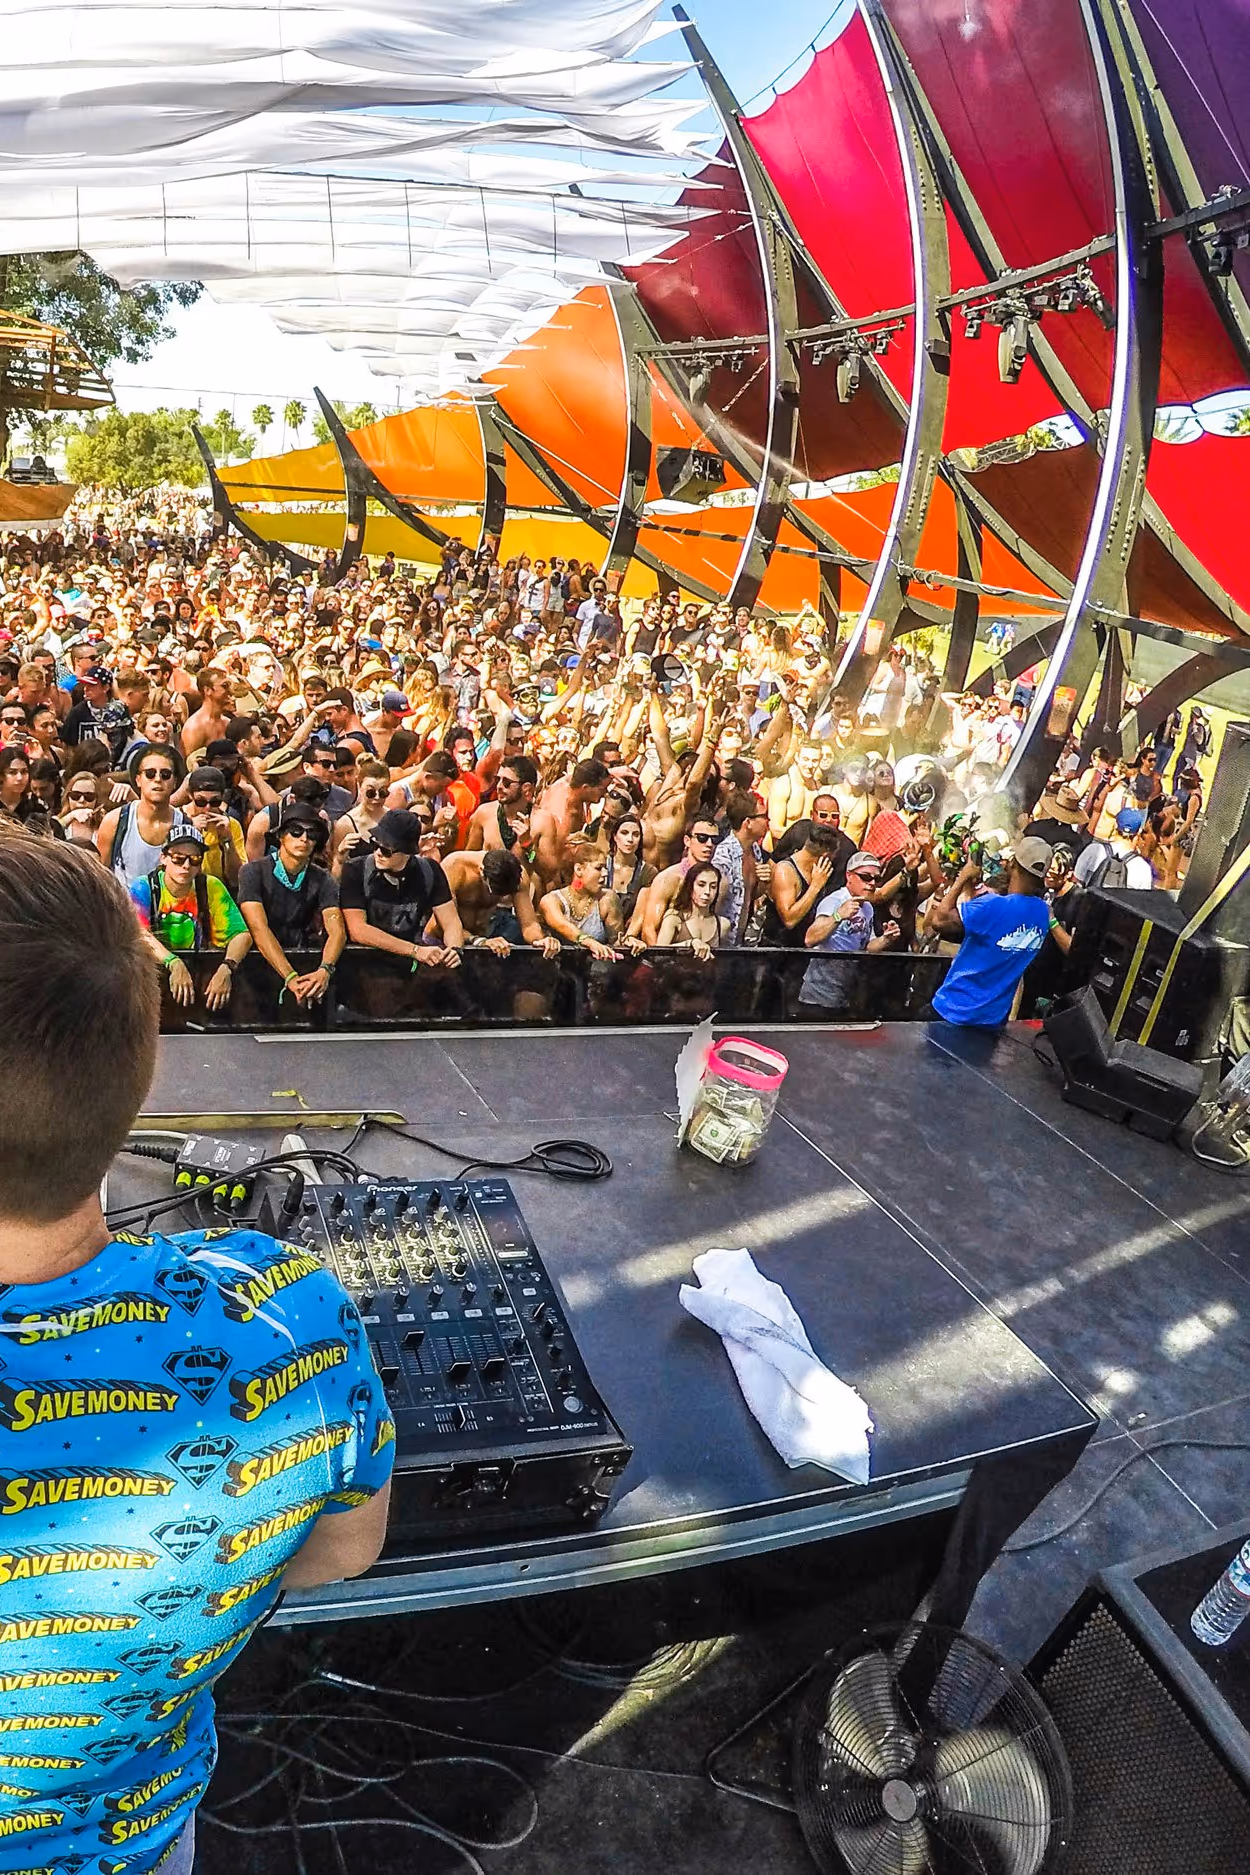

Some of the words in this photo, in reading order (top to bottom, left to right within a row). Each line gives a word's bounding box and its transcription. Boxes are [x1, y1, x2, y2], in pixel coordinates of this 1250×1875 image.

[170, 825, 184, 842] RED
[367, 1184, 418, 1193] Pioneer
[18, 1302, 171, 1345] SAVEMONEY
[245, 1346, 350, 1422] SAVEMONEY
[11, 1389, 179, 1432] SAVEMONEY
[234, 1426, 355, 1498] SAVEMONEY
[2, 1475, 177, 1515] SAVEMONEY
[111, 1782, 204, 1846] SAVEMONEY
